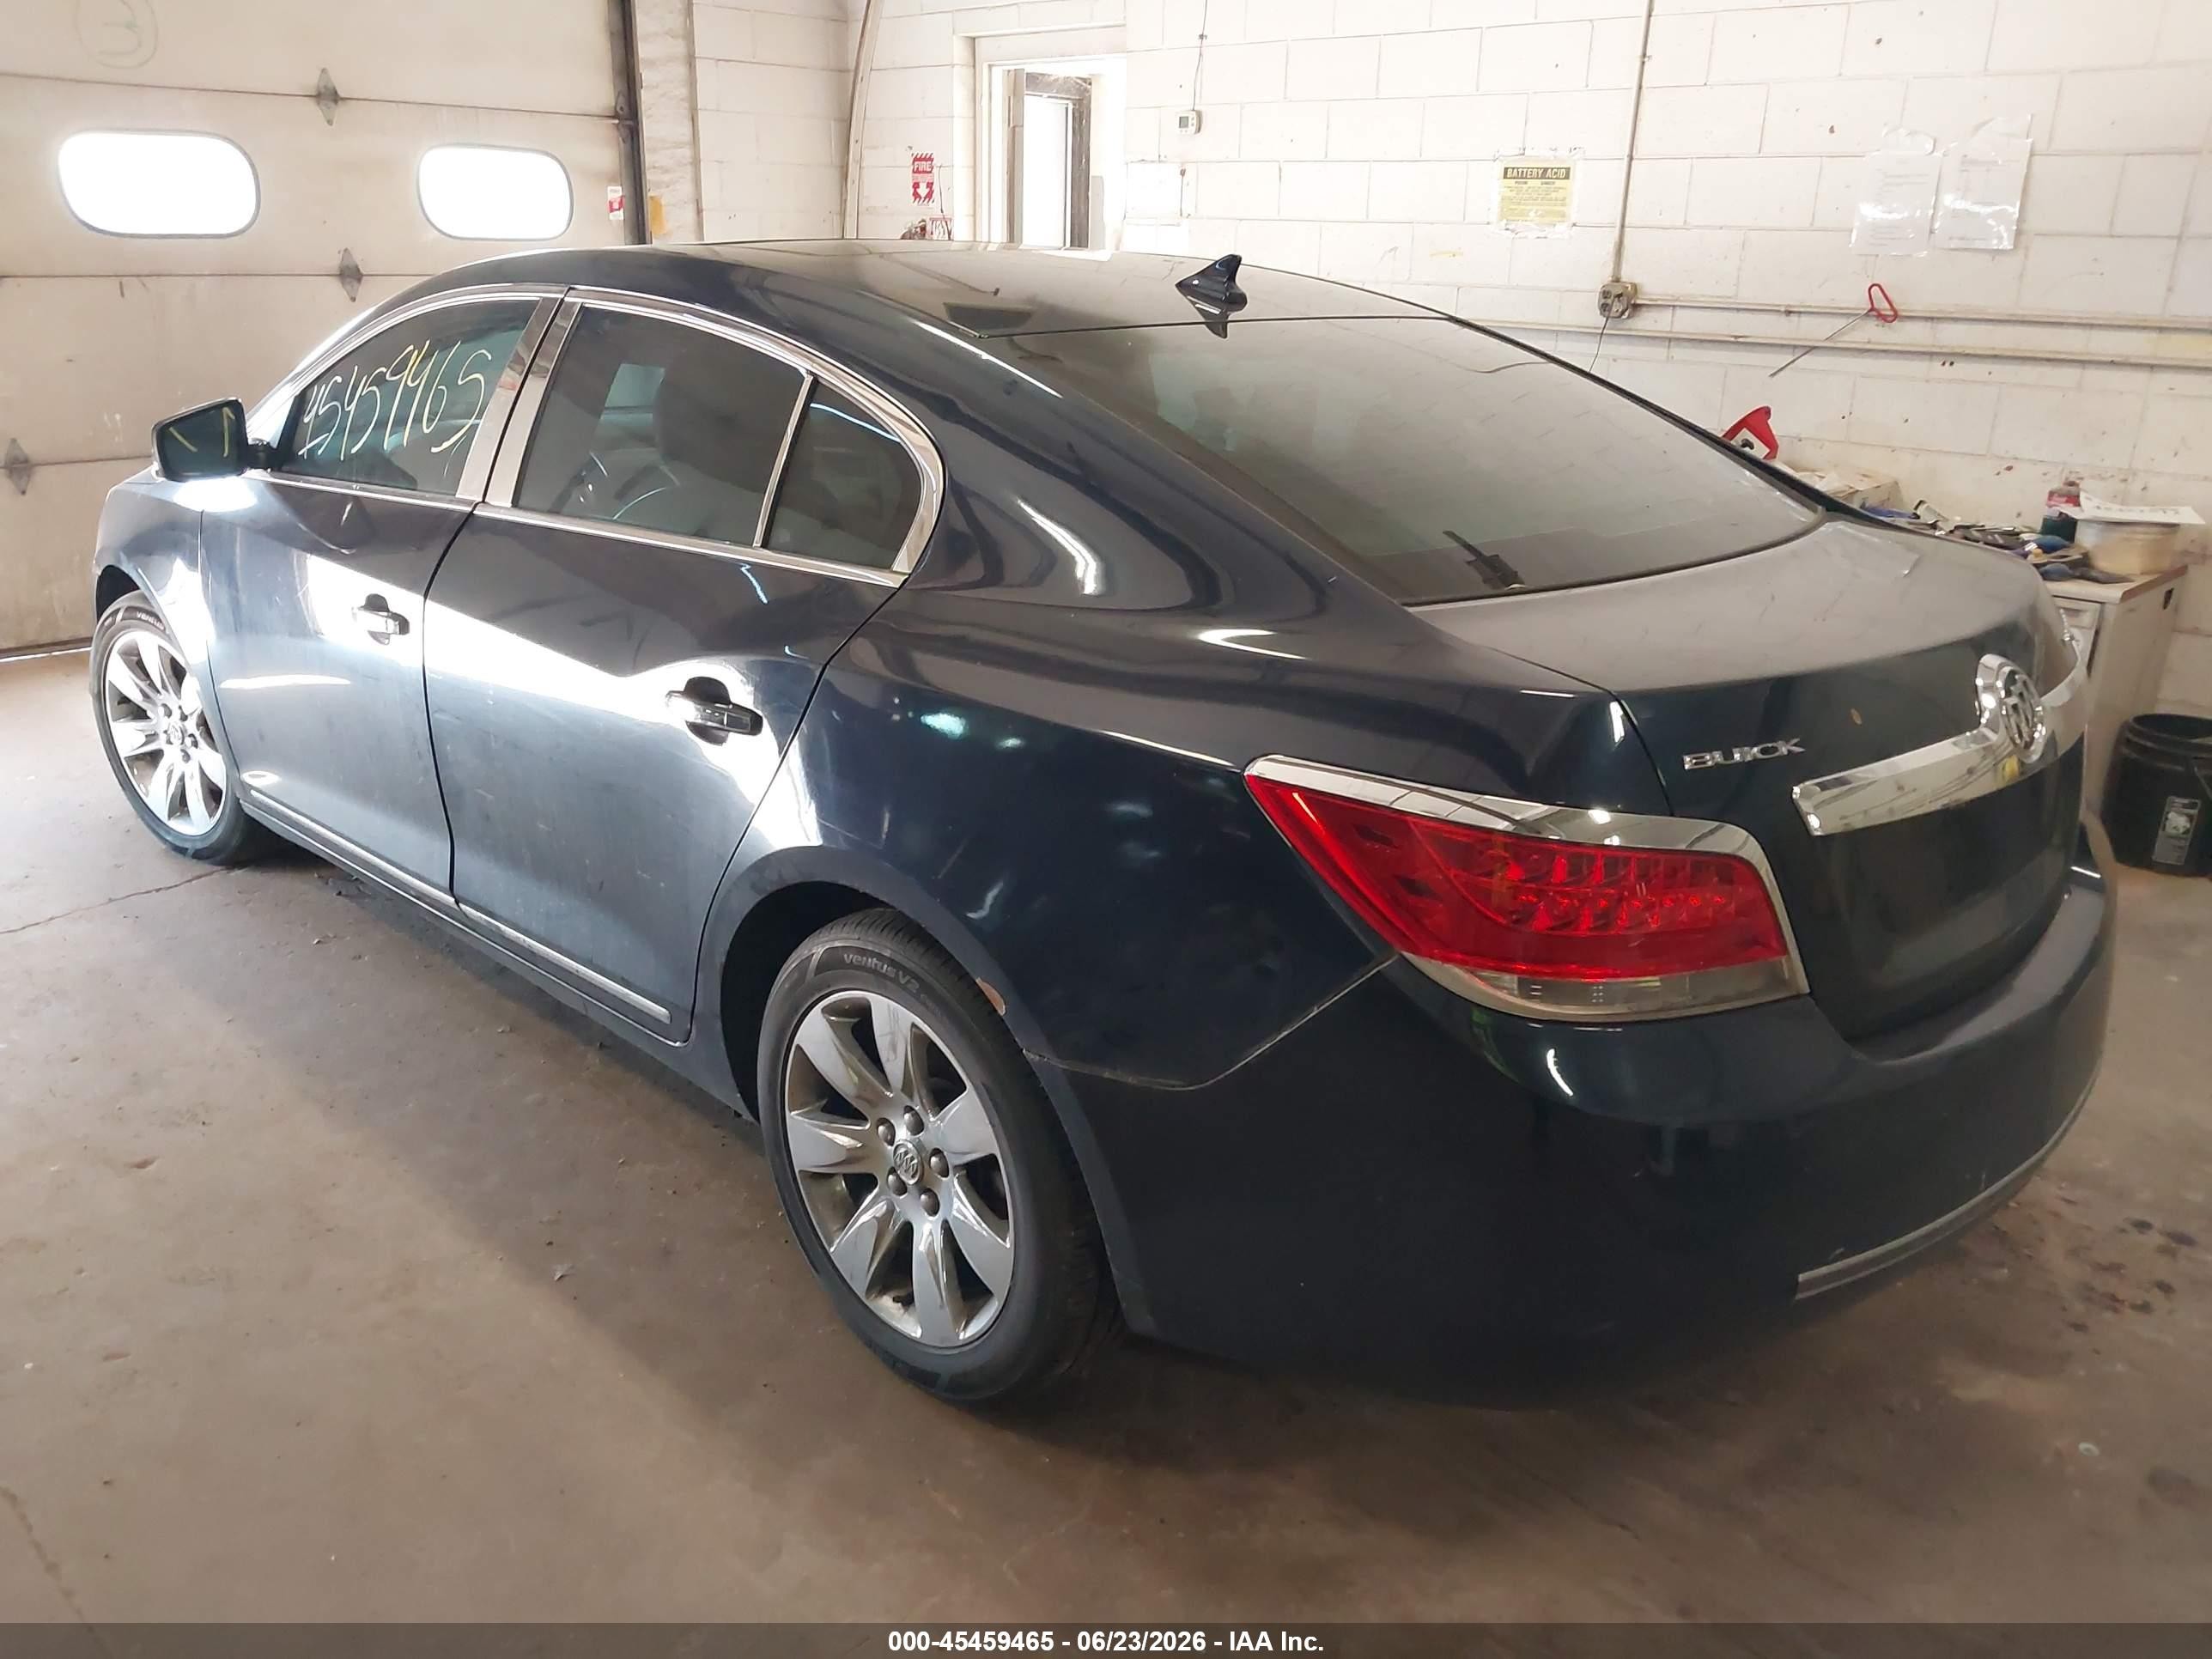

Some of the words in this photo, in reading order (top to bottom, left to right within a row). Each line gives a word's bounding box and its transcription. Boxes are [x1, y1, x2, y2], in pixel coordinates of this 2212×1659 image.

[914, 161, 933, 173] FIRE
[1506, 168, 1544, 179] BATTERY
[1546, 168, 1566, 179] ACID
[298, 339, 493, 461] 45459465
[1682, 738, 1807, 770] BUICK
